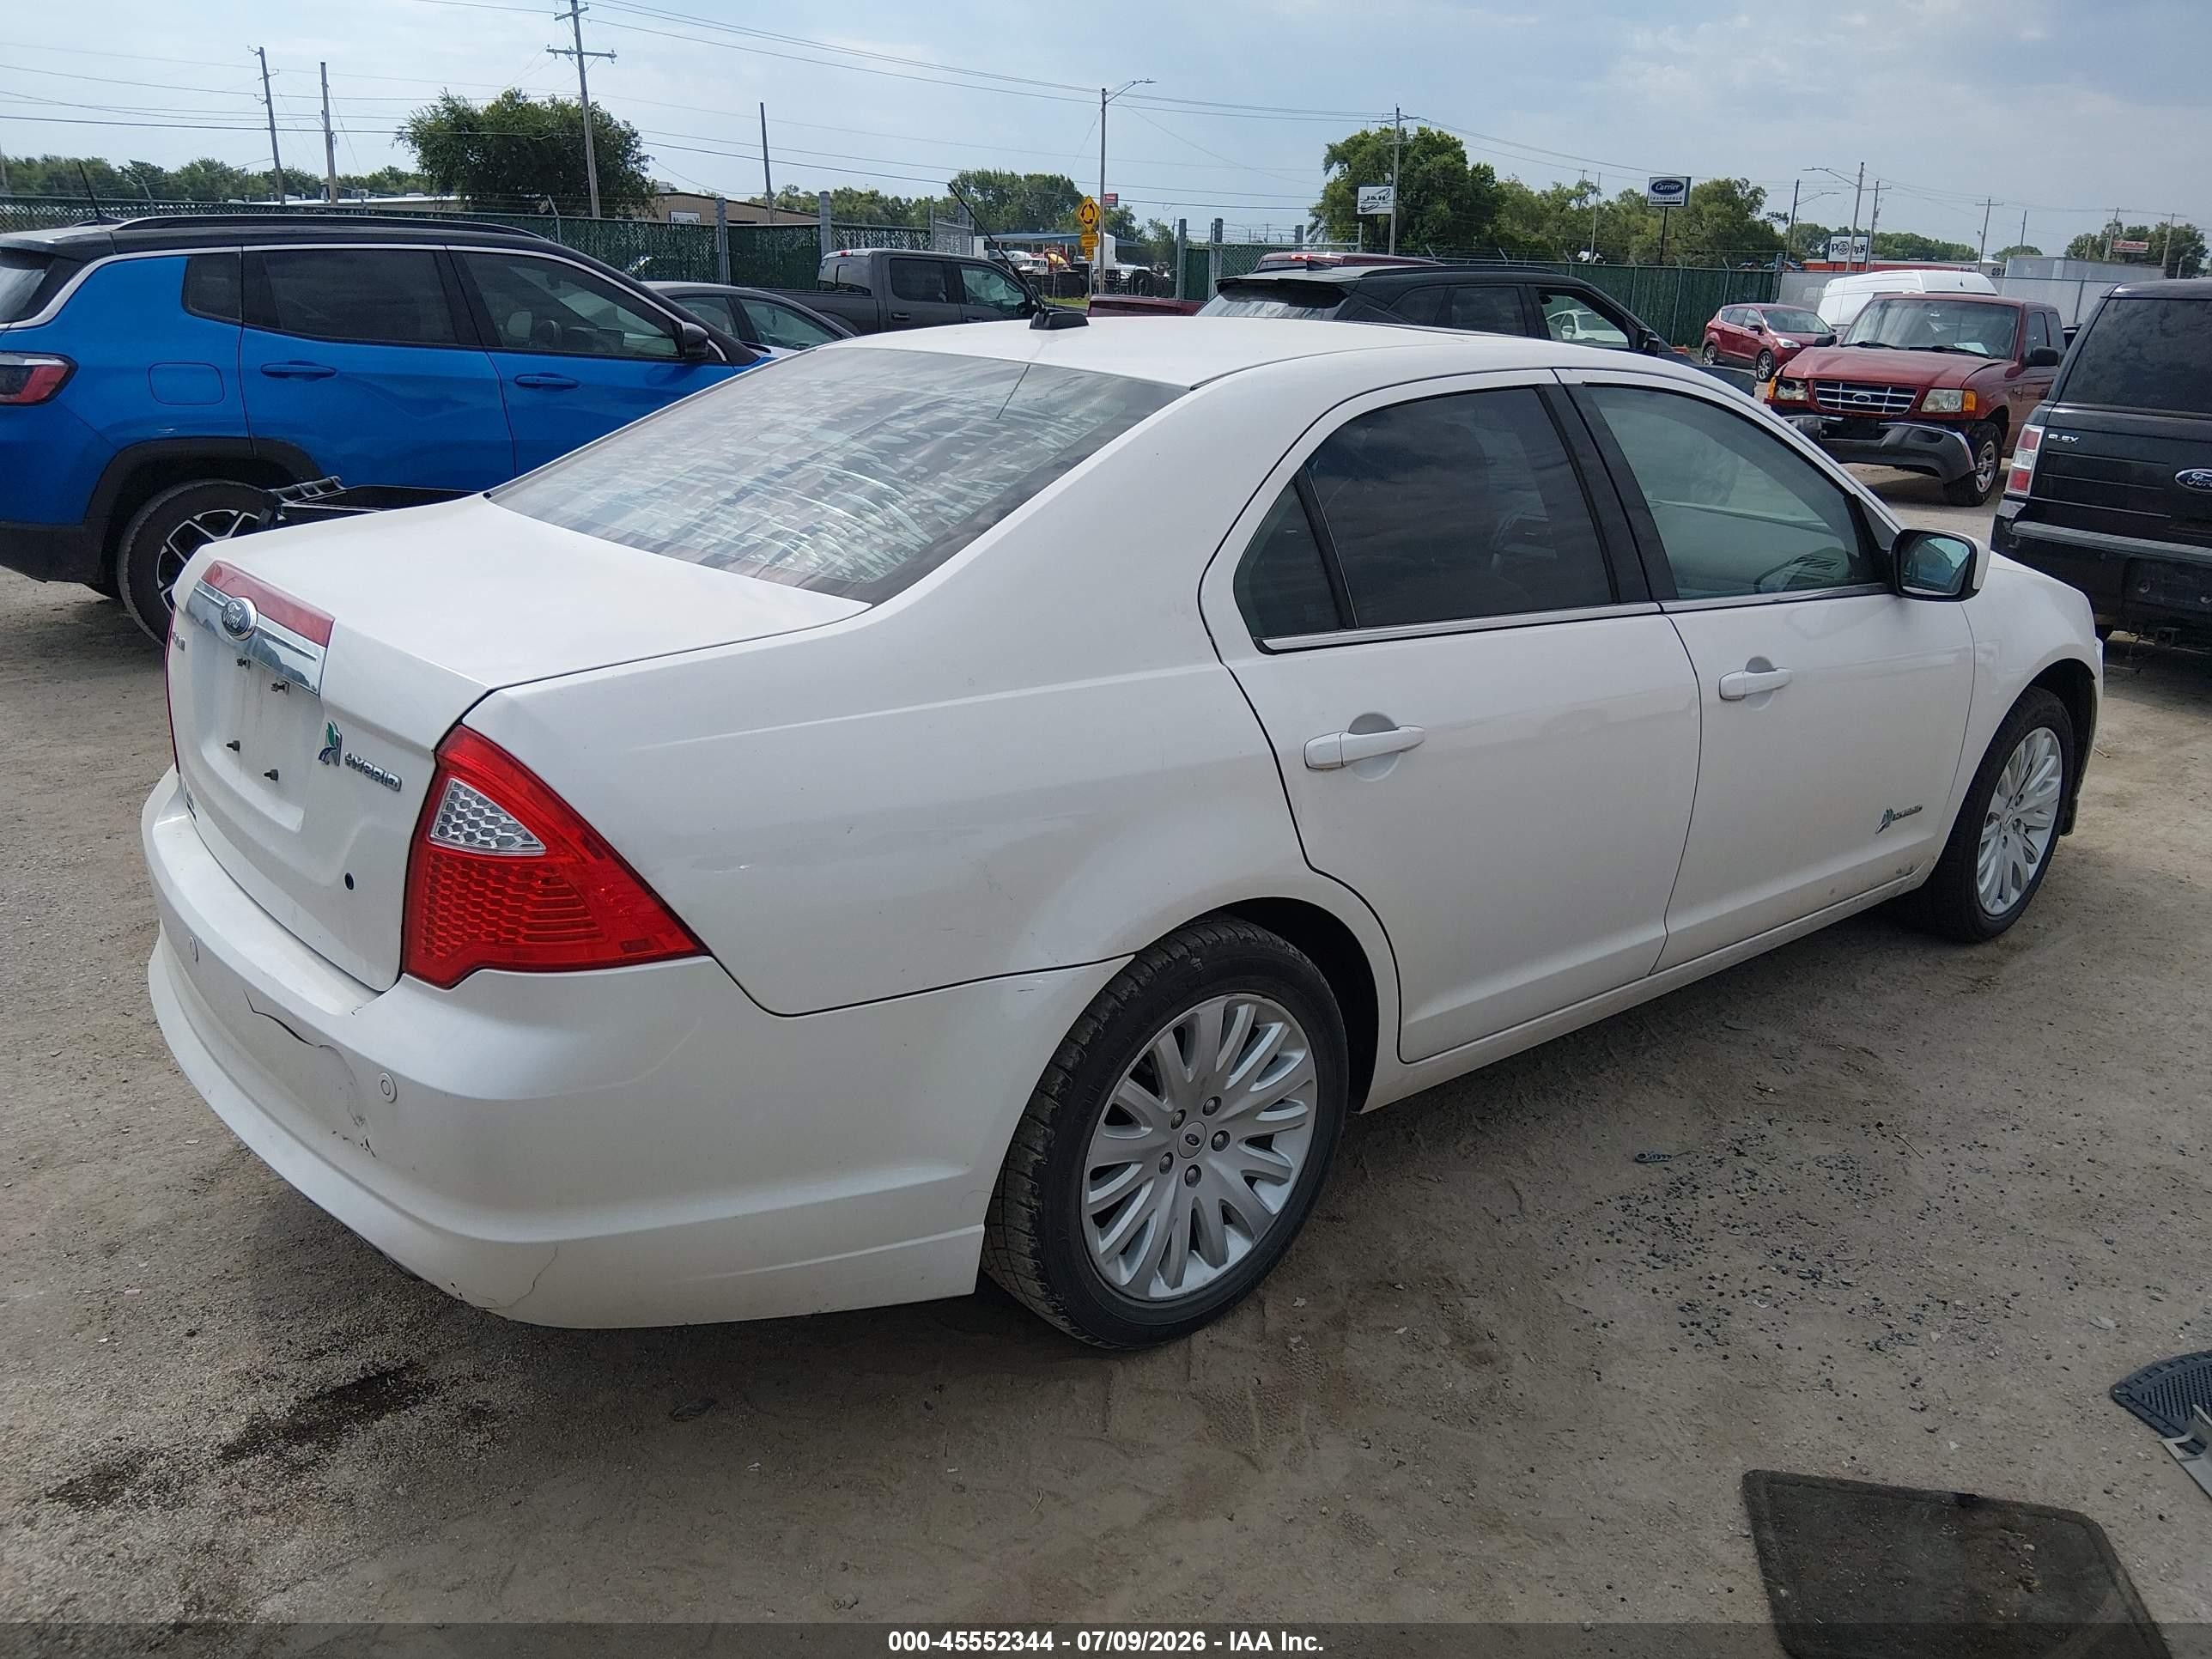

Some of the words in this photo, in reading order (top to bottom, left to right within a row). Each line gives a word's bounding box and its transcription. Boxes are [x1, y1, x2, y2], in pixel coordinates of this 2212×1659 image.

[1655, 182, 1680, 191] Carrier
[2048, 433, 2080, 444] FLEX
[222, 602, 244, 629] Ford
[344, 751, 402, 793] HYBRID
